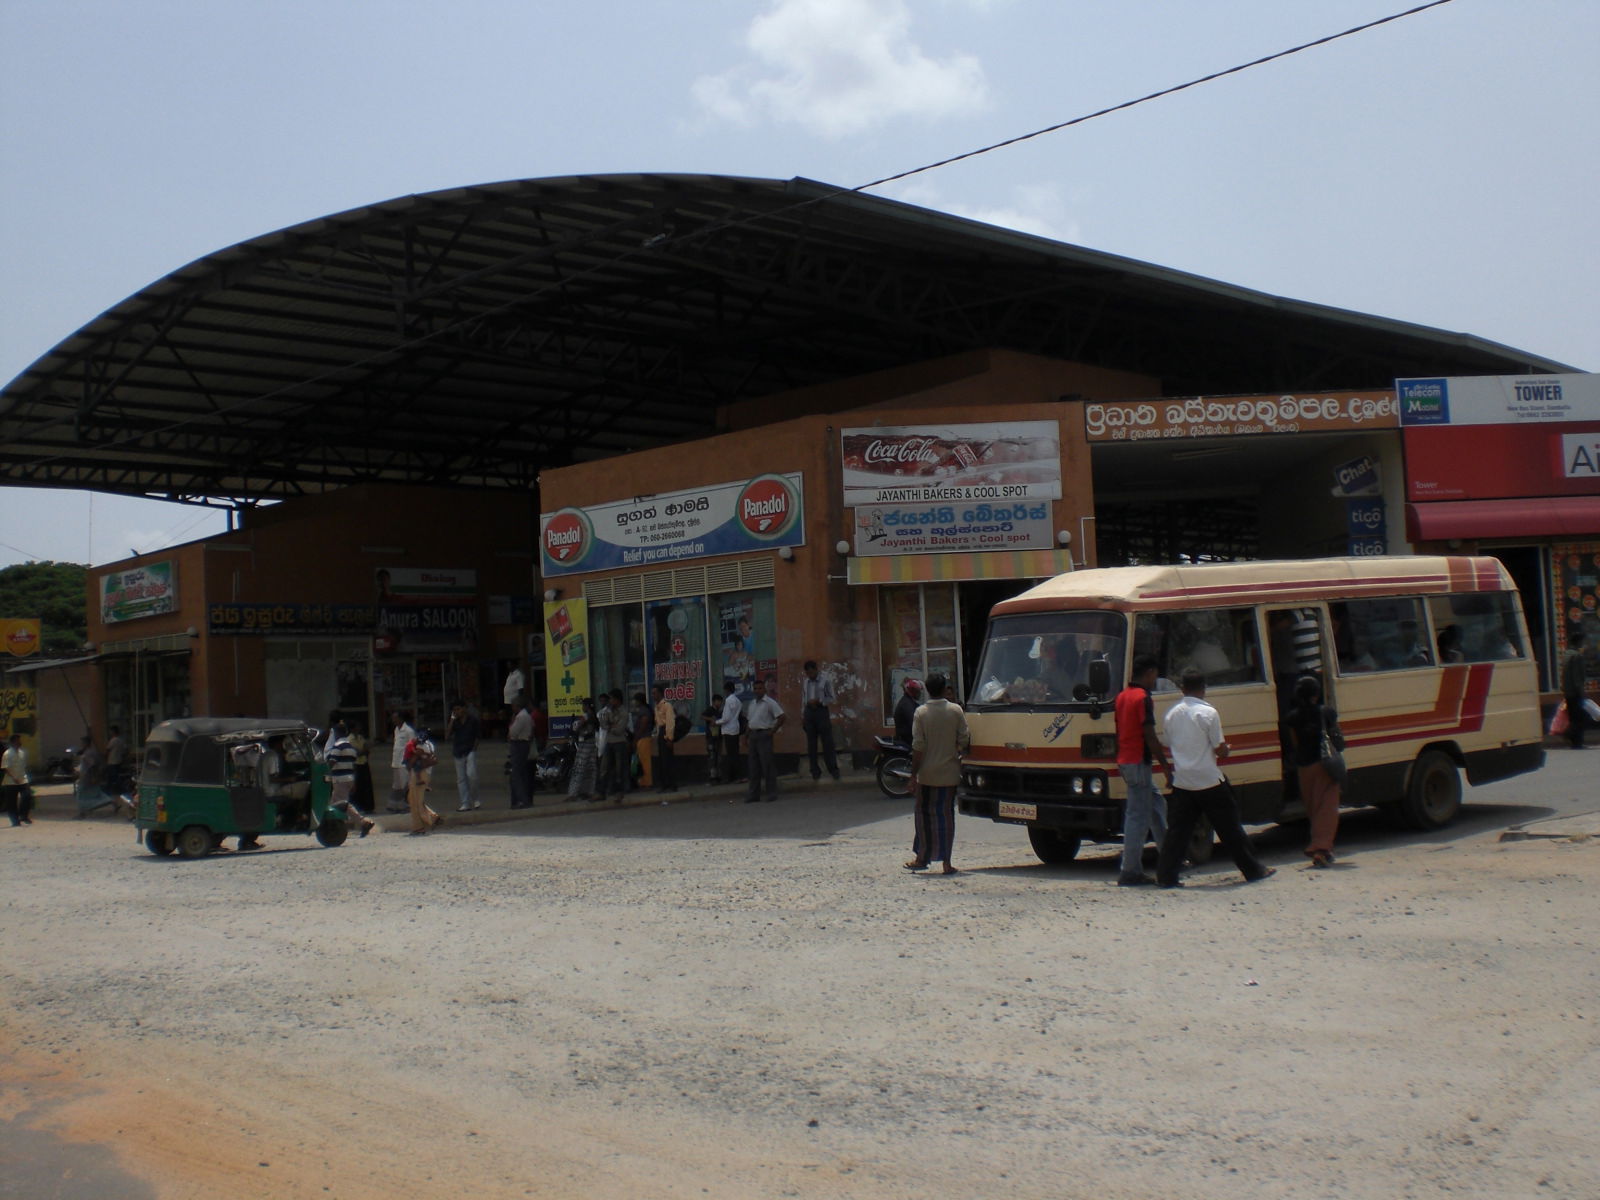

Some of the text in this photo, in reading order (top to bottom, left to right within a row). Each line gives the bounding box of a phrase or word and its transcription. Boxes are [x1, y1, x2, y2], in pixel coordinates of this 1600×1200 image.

[1403, 386, 1441, 397] Telecom
[1514, 385, 1562, 401] TOWER
[1339, 458, 1373, 485] Chat
[876, 485, 1028, 501] JAYANTHI BAKERS & COOL SPOT
[1415, 480, 1438, 489] Tower
[744, 493, 786, 519] Panadol
[547, 528, 580, 548] Panadol
[880, 536, 926, 548] Jayanthi
[931, 534, 969, 544] Bakers
[980, 533, 1004, 543] Cool
[1007, 533, 1030, 544] spot
[623, 542, 704, 563] Relief you can depend on
[380, 607, 419, 626] Anura
[423, 607, 477, 628] SALOON
[654, 660, 703, 681] PHARMACY
